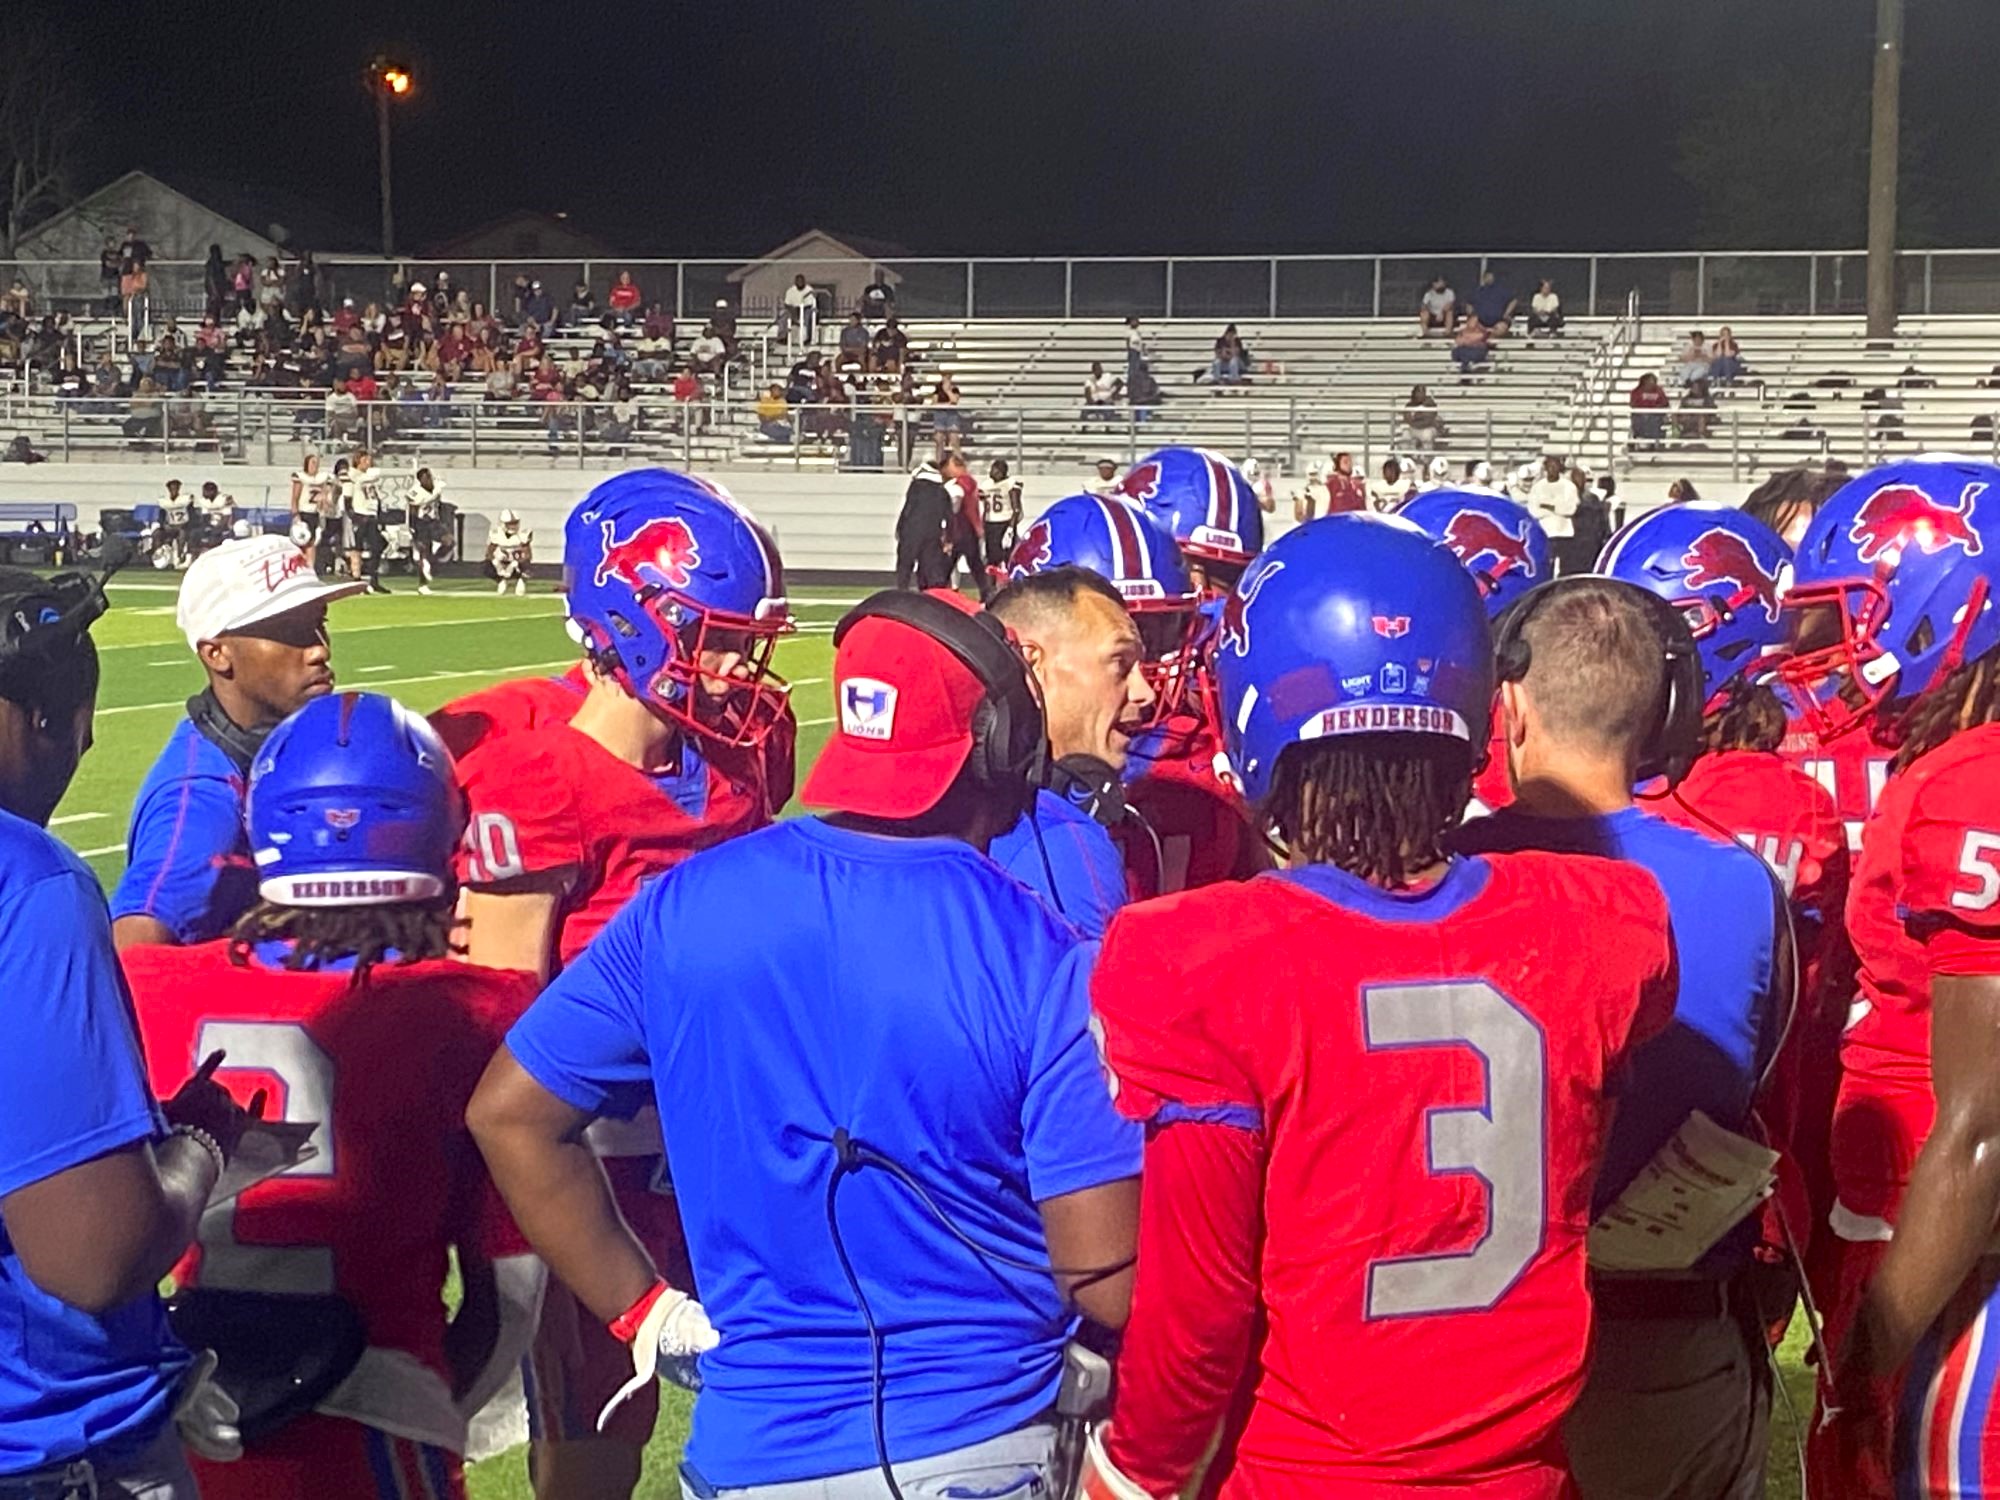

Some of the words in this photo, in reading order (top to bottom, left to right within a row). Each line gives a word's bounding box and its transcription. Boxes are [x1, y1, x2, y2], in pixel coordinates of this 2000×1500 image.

[1322, 706, 1454, 734] HENDERSON
[291, 879, 407, 899] HENDERSON
[1360, 981, 1547, 1320] 3
